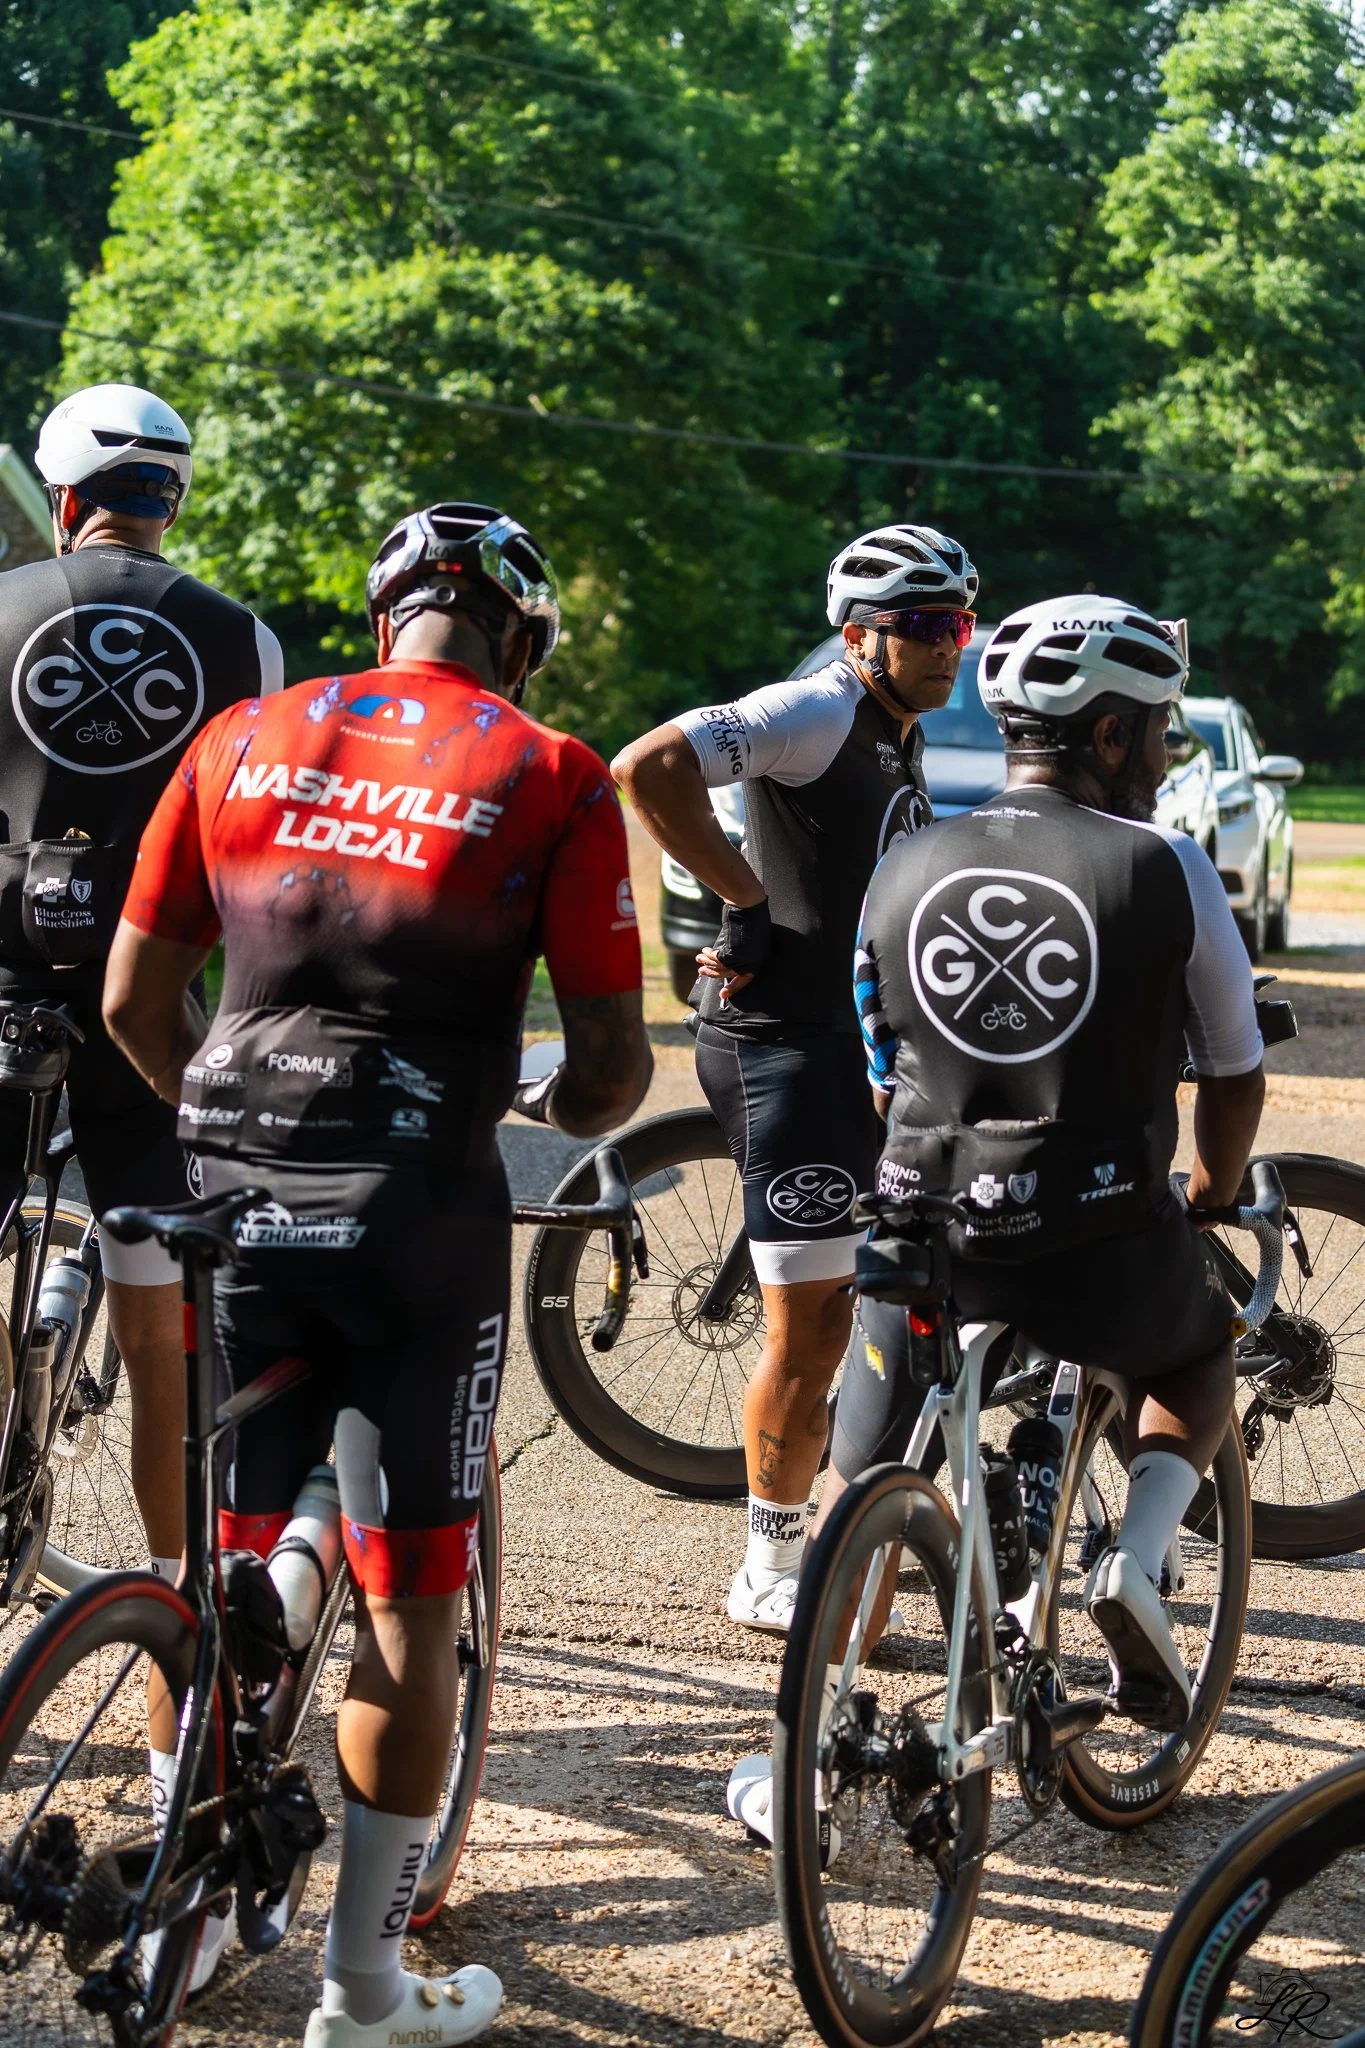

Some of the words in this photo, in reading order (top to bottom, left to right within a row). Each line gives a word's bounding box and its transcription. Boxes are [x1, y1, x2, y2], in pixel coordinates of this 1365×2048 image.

[1053, 619, 1115, 633] KASK
[226, 763, 504, 838] NASHVILLE
[273, 810, 429, 870] LOCAL
[35, 907, 92, 919] BlueCross
[35, 915, 95, 928] BlueShield
[881, 1159, 921, 1182] GRIND
[1078, 1182, 1135, 1202] TREK
[528, 1244, 541, 1295] PIRELLI
[541, 1296, 570, 1308] 65
[450, 1374, 468, 1436] BICYCLE
[450, 1440, 461, 1482] SHOP
[752, 1504, 800, 1523] GRIND
[1111, 1779, 1160, 1802] RESERVE
[379, 1843, 424, 1939] nimbl
[389, 2024, 442, 2045] nimbl
